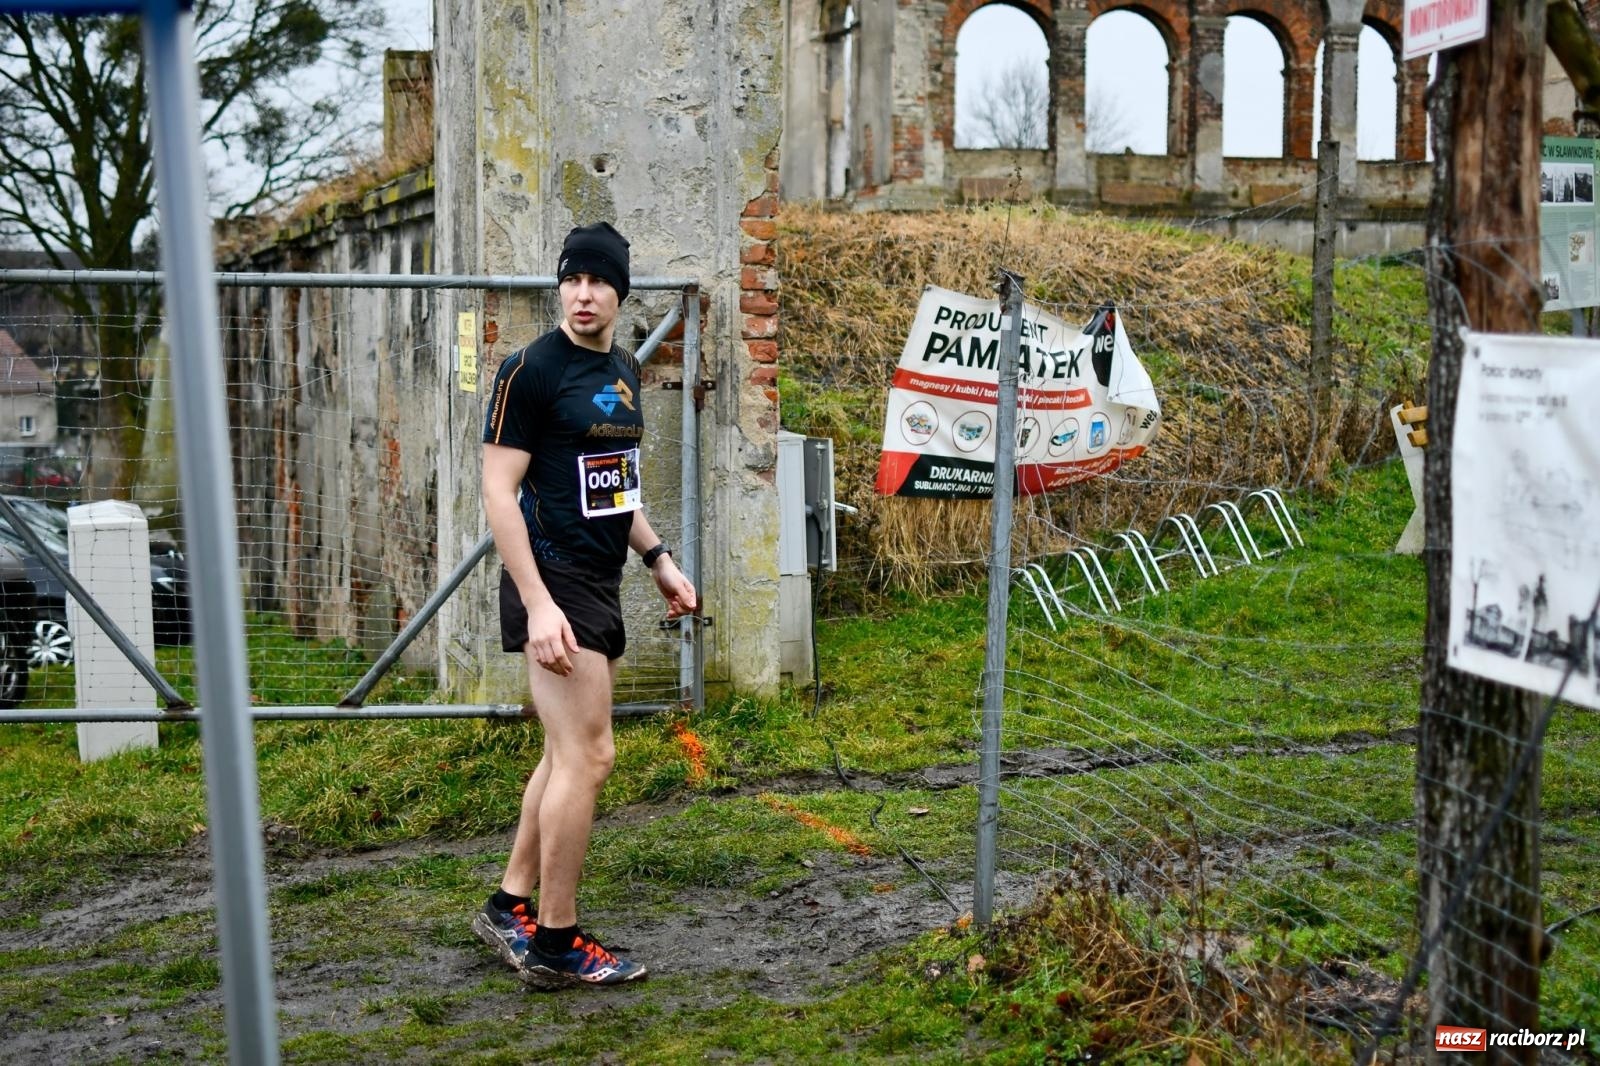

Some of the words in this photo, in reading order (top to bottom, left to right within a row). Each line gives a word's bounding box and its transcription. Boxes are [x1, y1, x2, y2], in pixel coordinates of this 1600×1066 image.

[934, 305, 1048, 343] PRODUENT
[909, 377, 950, 393] magnesy
[956, 384, 979, 396] kubki
[588, 469, 621, 490] 006
[929, 466, 994, 484] DRUKARNI
[914, 480, 971, 492] SUBLIMACYJNA
